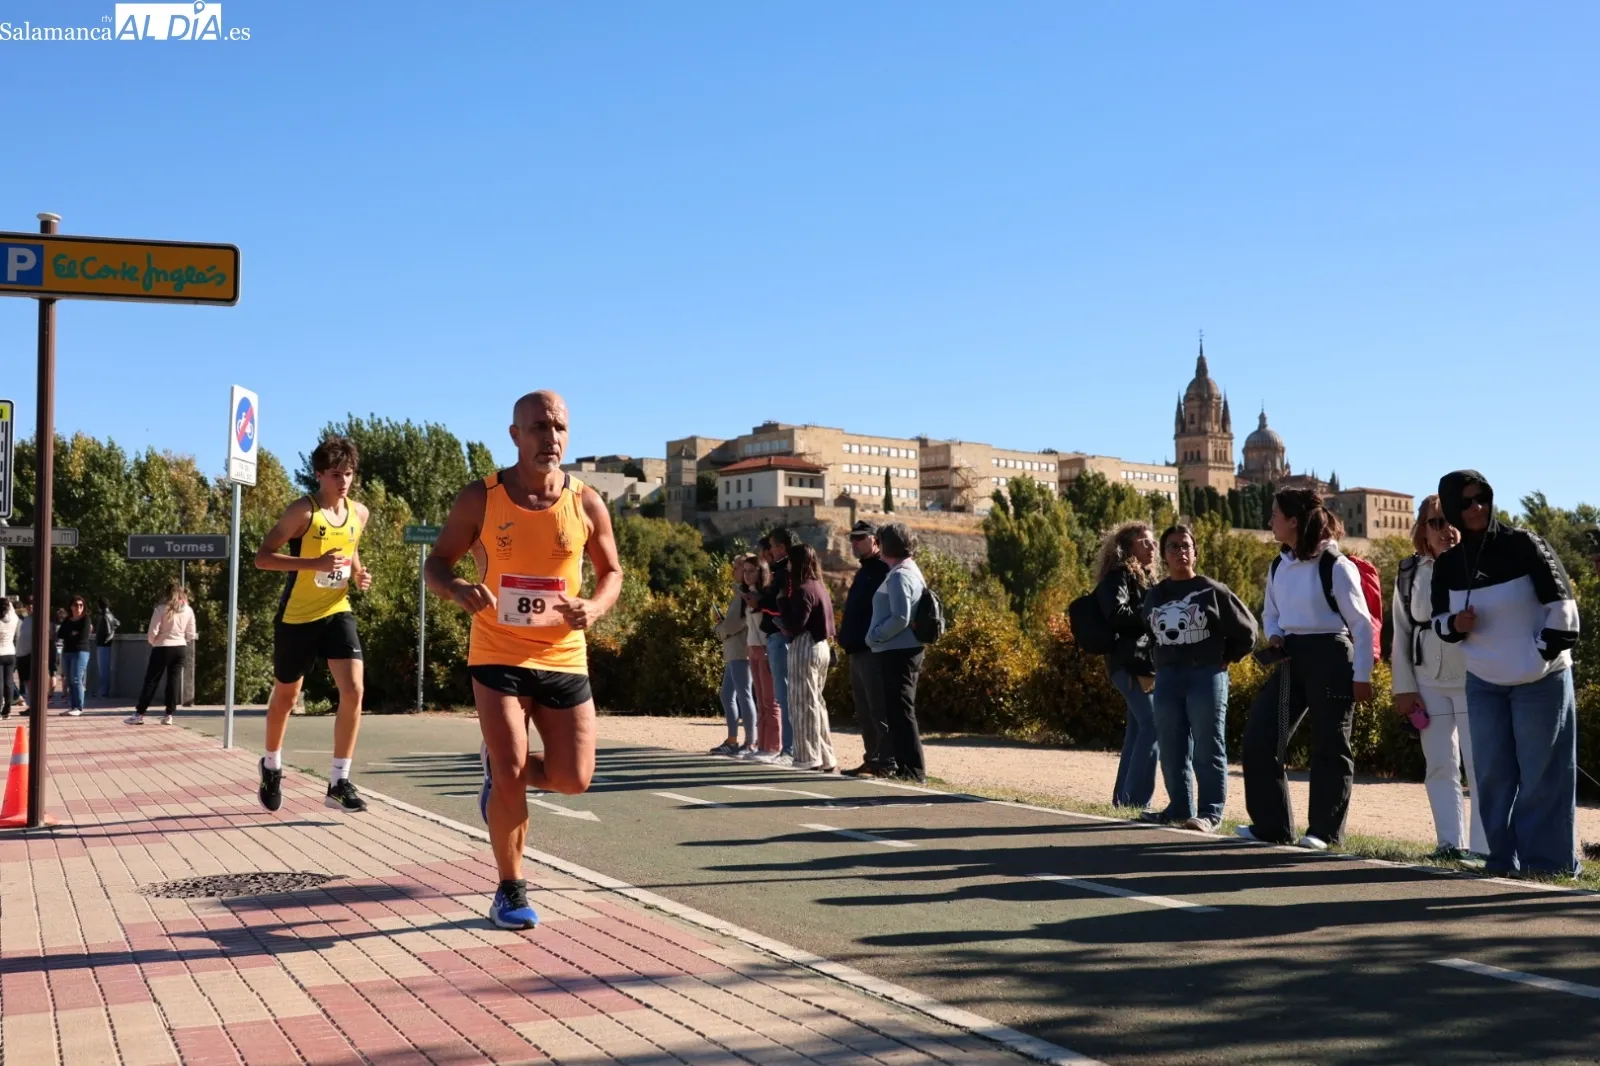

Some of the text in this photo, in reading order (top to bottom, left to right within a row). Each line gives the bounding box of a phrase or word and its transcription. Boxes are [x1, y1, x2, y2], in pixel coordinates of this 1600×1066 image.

[7, 247, 226, 292] P El Corte Inglés
[16, 535, 34, 543] Fab
[165, 541, 214, 552] Tormes
[327, 571, 343, 581] 48
[517, 596, 546, 615] 89
